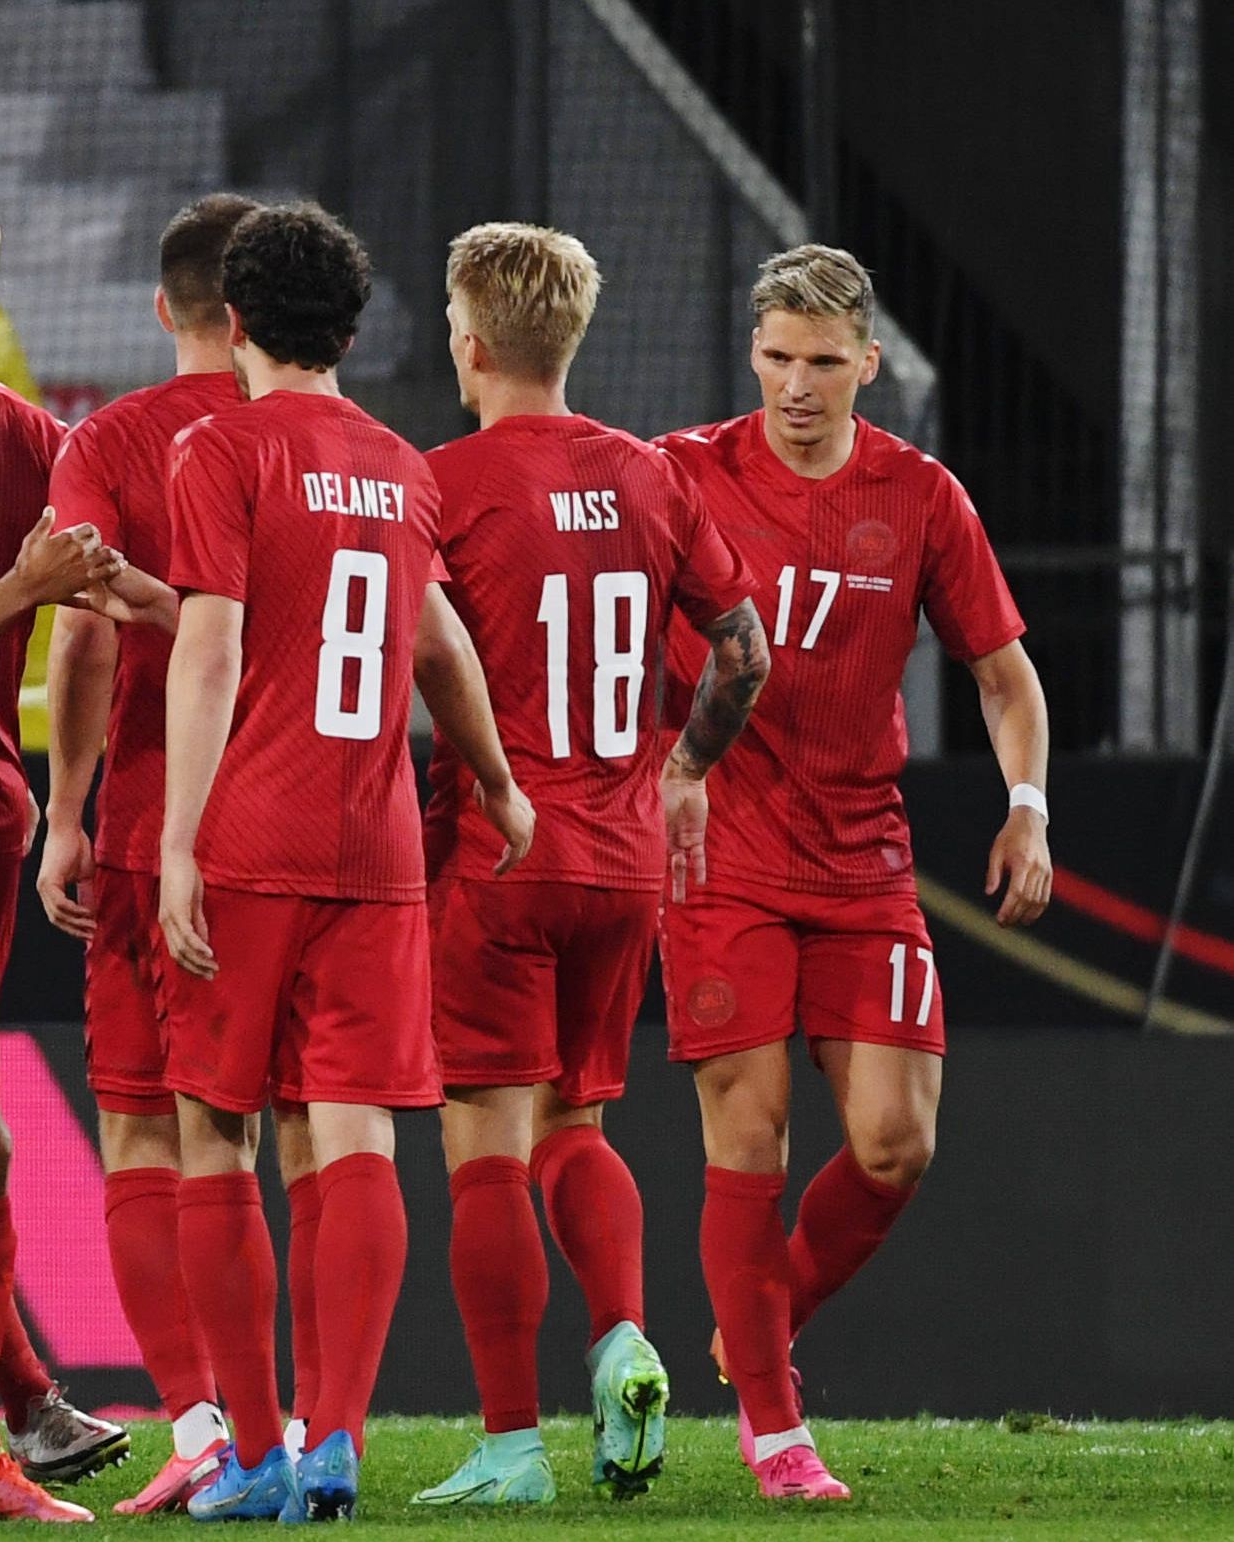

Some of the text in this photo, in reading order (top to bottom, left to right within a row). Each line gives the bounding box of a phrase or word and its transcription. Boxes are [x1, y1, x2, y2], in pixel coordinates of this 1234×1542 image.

[302, 472, 404, 523] DELANEY
[549, 490, 619, 531] WASS
[314, 548, 388, 740] 8
[773, 565, 841, 650] 17
[536, 571, 648, 759] 18
[889, 943, 934, 1026] 17
